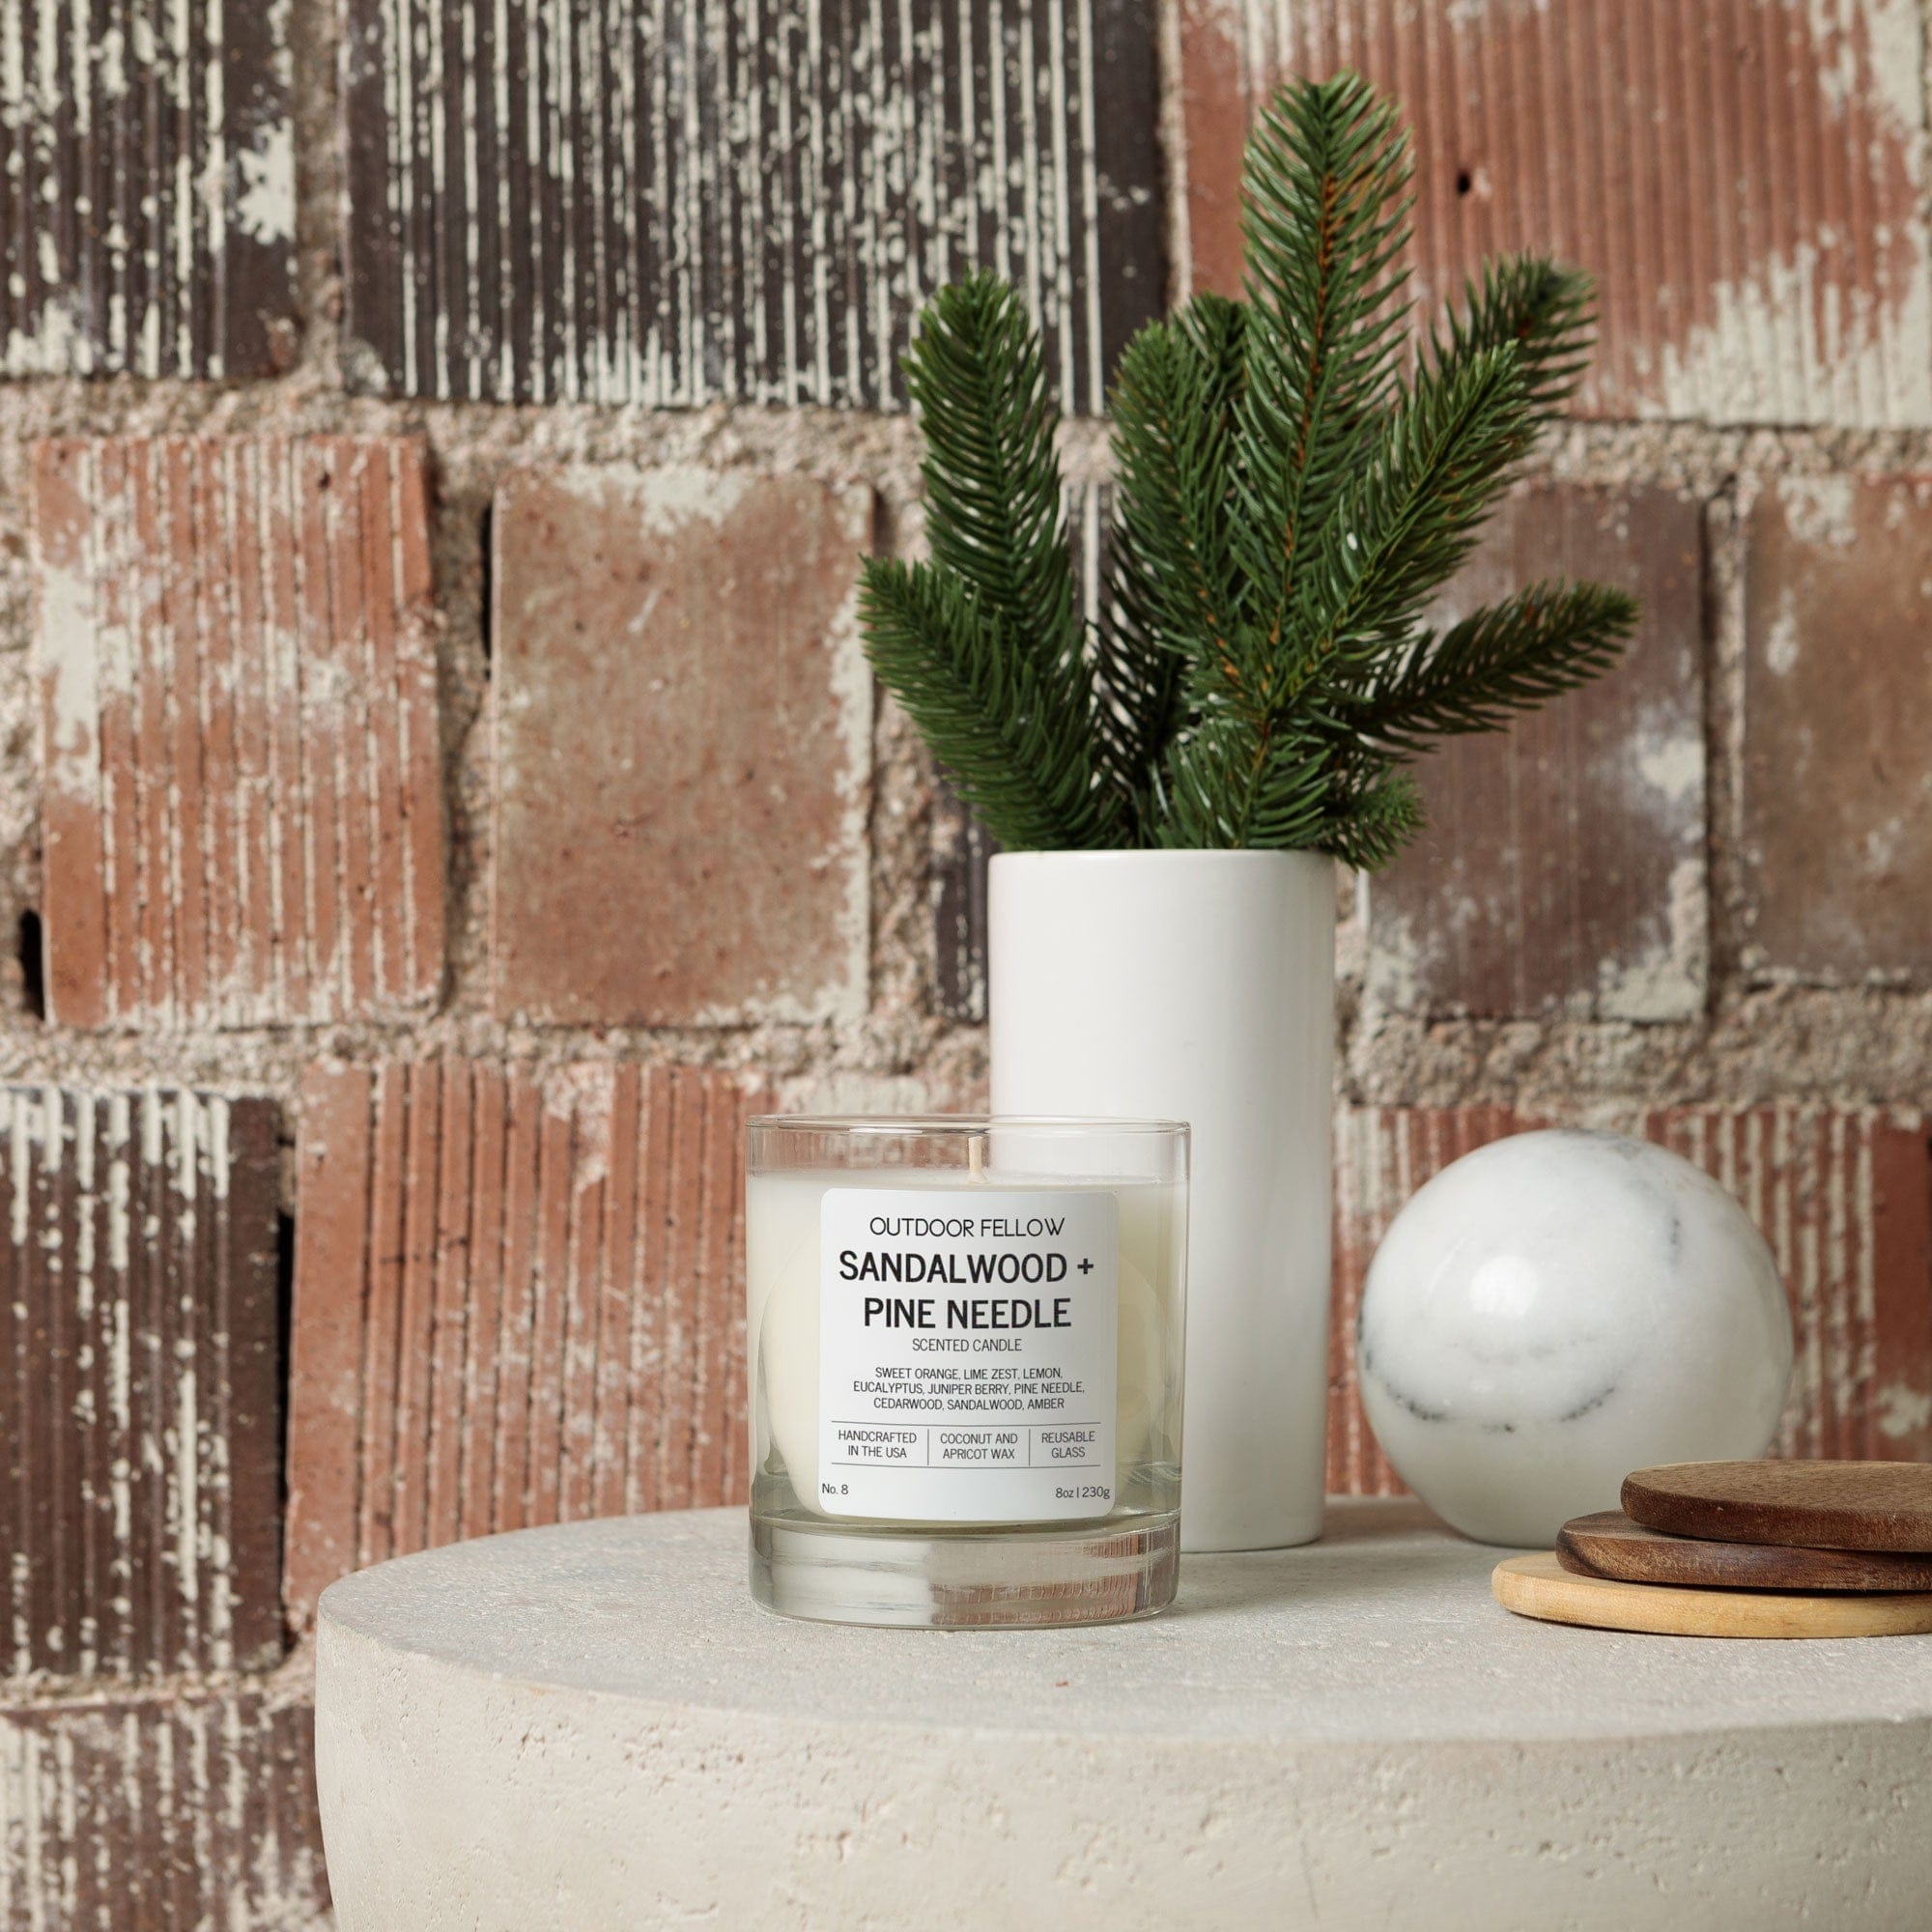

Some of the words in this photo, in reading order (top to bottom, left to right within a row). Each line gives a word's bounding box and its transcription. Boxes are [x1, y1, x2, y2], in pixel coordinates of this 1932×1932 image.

[869, 1217, 975, 1237] OUTDOOR
[980, 1217, 1065, 1237] FELLOW
[839, 1250, 1067, 1284] SANDALWOOD
[1077, 1258, 1094, 1275] +
[865, 1297, 935, 1329] PINE
[948, 1297, 1071, 1329] NEEDLE
[912, 1338, 970, 1351] SCENTED
[973, 1339, 1022, 1351] CANDLE
[875, 1367, 912, 1379] SWEET
[915, 1368, 961, 1380] ORANGE,
[963, 1368, 989, 1380] LIME
[1023, 1367, 1063, 1379] LEMON,
[853, 1381, 925, 1395] EUCALYPTUS,
[927, 1382, 973, 1395] JUNIPER
[975, 1382, 1011, 1396] BERRY,
[1013, 1382, 1038, 1395] PINE
[1041, 1381, 1085, 1394] NEEDLE,
[873, 1398, 945, 1410] CEDARWOOD,
[947, 1398, 1025, 1410] SANDALWOOD,
[1027, 1398, 1065, 1409] AMBER
[838, 1430, 917, 1443] HANDCRAFTED
[940, 1433, 992, 1444] COCONUT
[995, 1433, 1018, 1444] AND
[1041, 1431, 1096, 1443] REUSABLE
[847, 1446, 859, 1457] IN
[862, 1446, 883, 1458] THE
[885, 1446, 907, 1459] USA
[943, 1448, 988, 1460] APRICOT
[990, 1448, 1015, 1460] WAX
[1051, 1446, 1086, 1459] GLASS
[822, 1483, 838, 1494] No.
[840, 1484, 849, 1495] 8
[1055, 1488, 1074, 1498] 8oz
[1082, 1486, 1111, 1500] 230g
